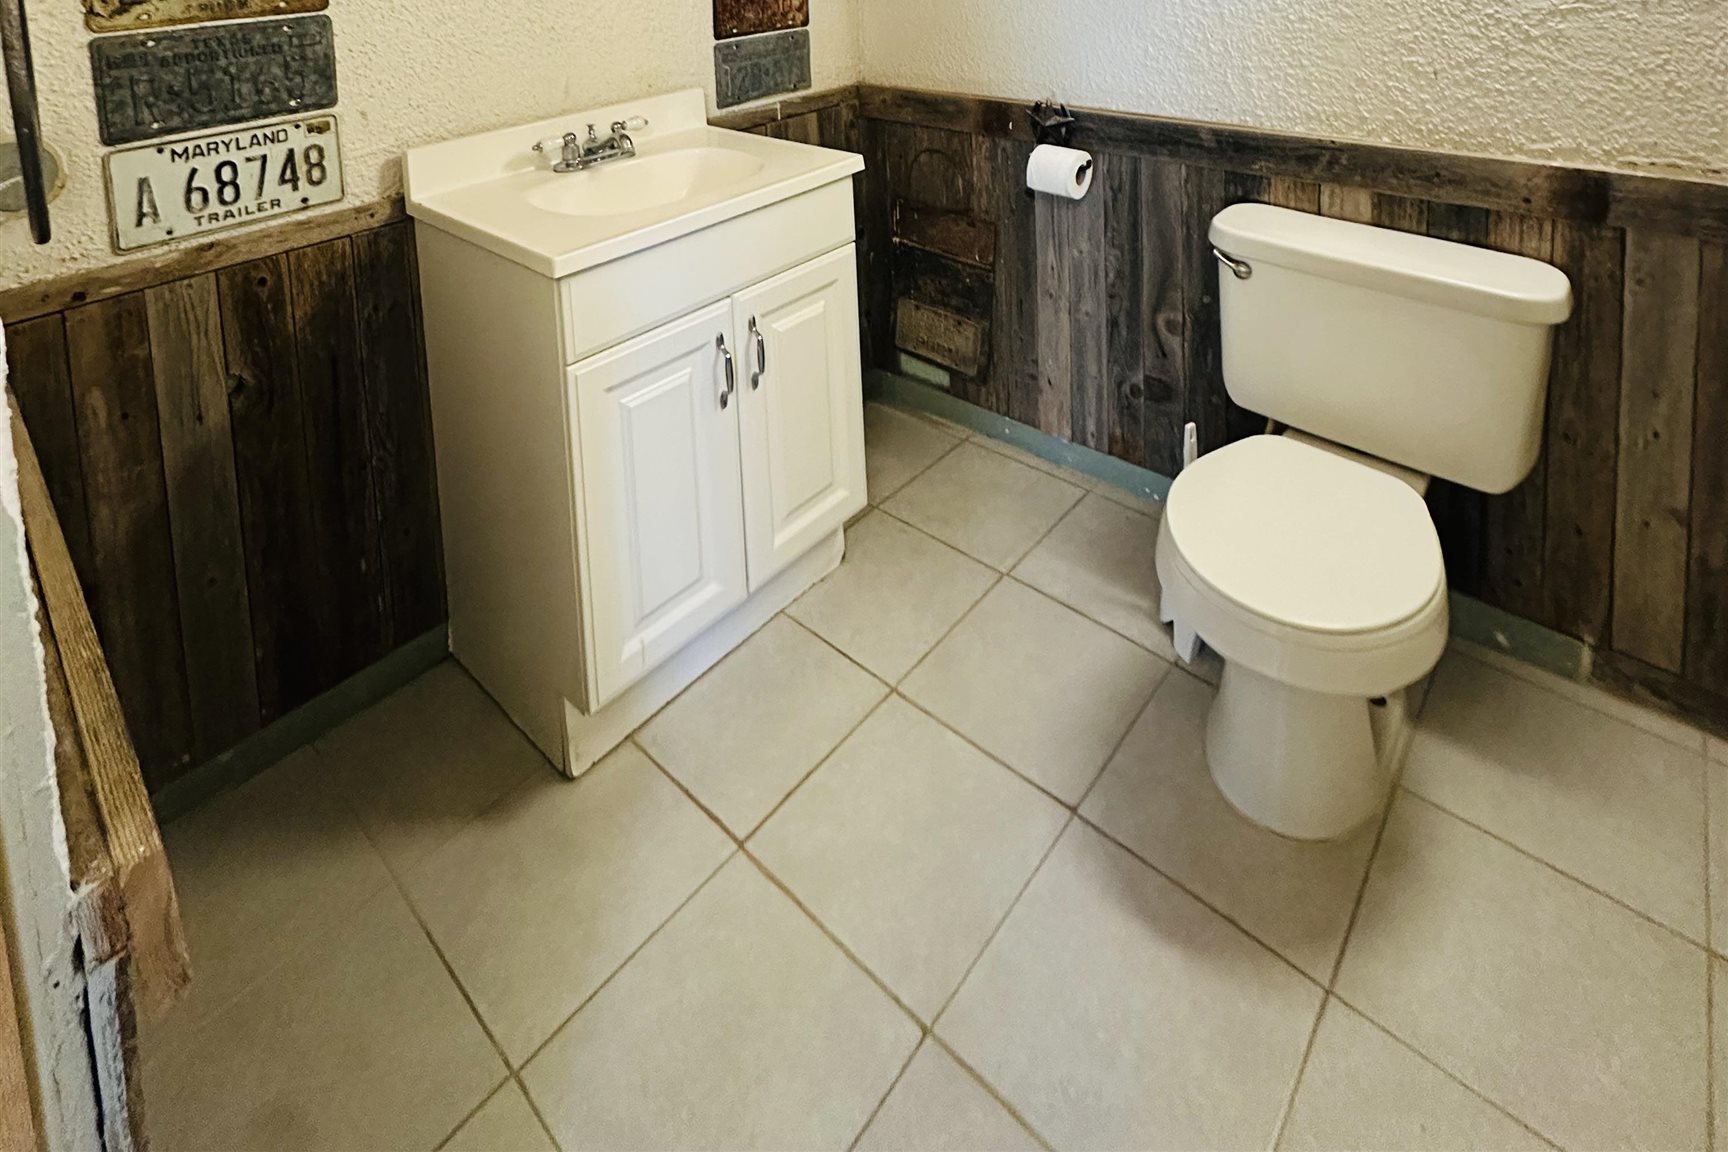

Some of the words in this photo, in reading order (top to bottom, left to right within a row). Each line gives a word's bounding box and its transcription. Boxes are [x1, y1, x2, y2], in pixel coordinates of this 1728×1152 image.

[170, 129, 288, 163] MARYLAND
[136, 176, 161, 227] A
[184, 143, 327, 214] 68748
[194, 198, 282, 226] TRAILER
